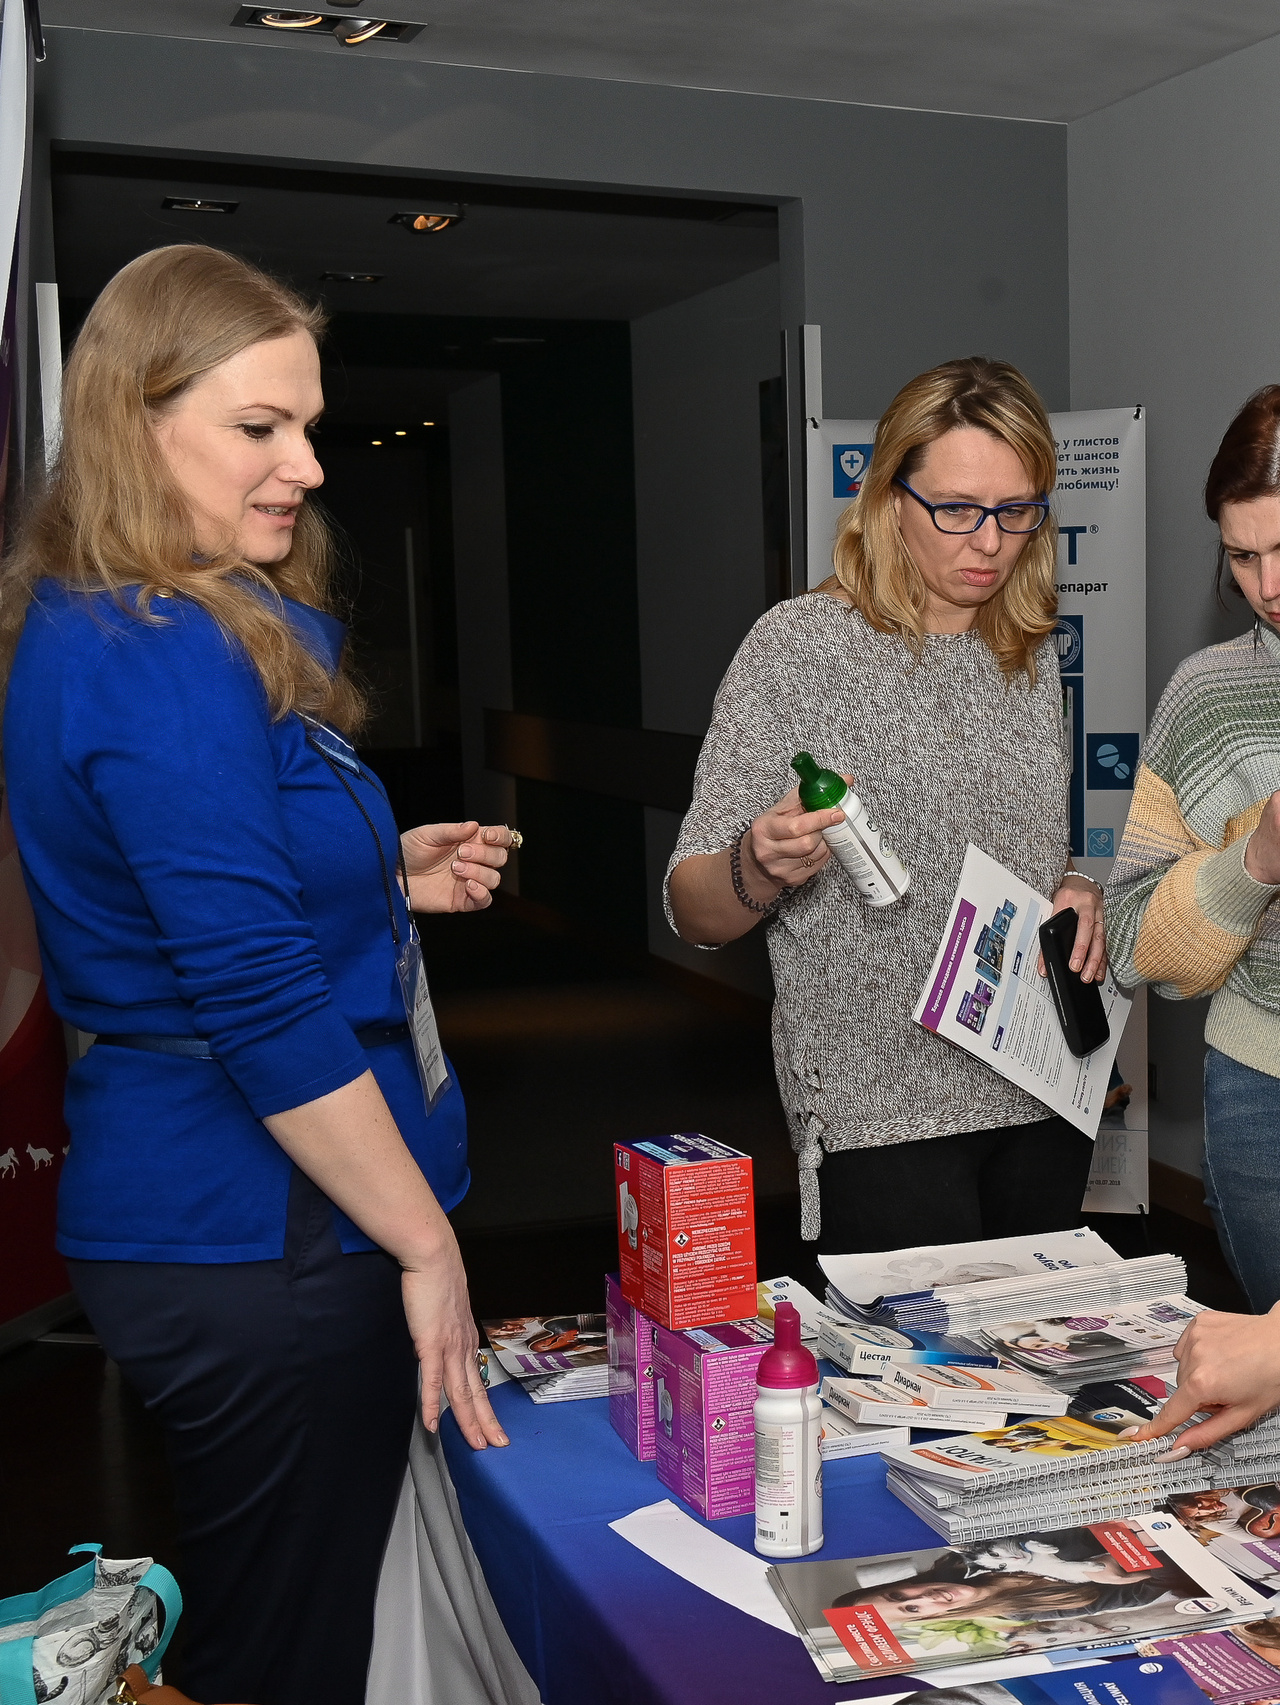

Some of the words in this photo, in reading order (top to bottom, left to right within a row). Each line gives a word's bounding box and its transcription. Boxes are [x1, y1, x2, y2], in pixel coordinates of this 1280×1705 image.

[1063, 439, 1070, 450] у
[1073, 437, 1119, 447] глистов
[1074, 451, 1119, 461] шансов
[1081, 466, 1119, 475] жизнь
[859, 1351, 891, 1362] Цестал
[894, 1370, 922, 1394] Диаркан
[828, 1386, 851, 1410] Диаркан
[846, 1622, 865, 1643] вместе
